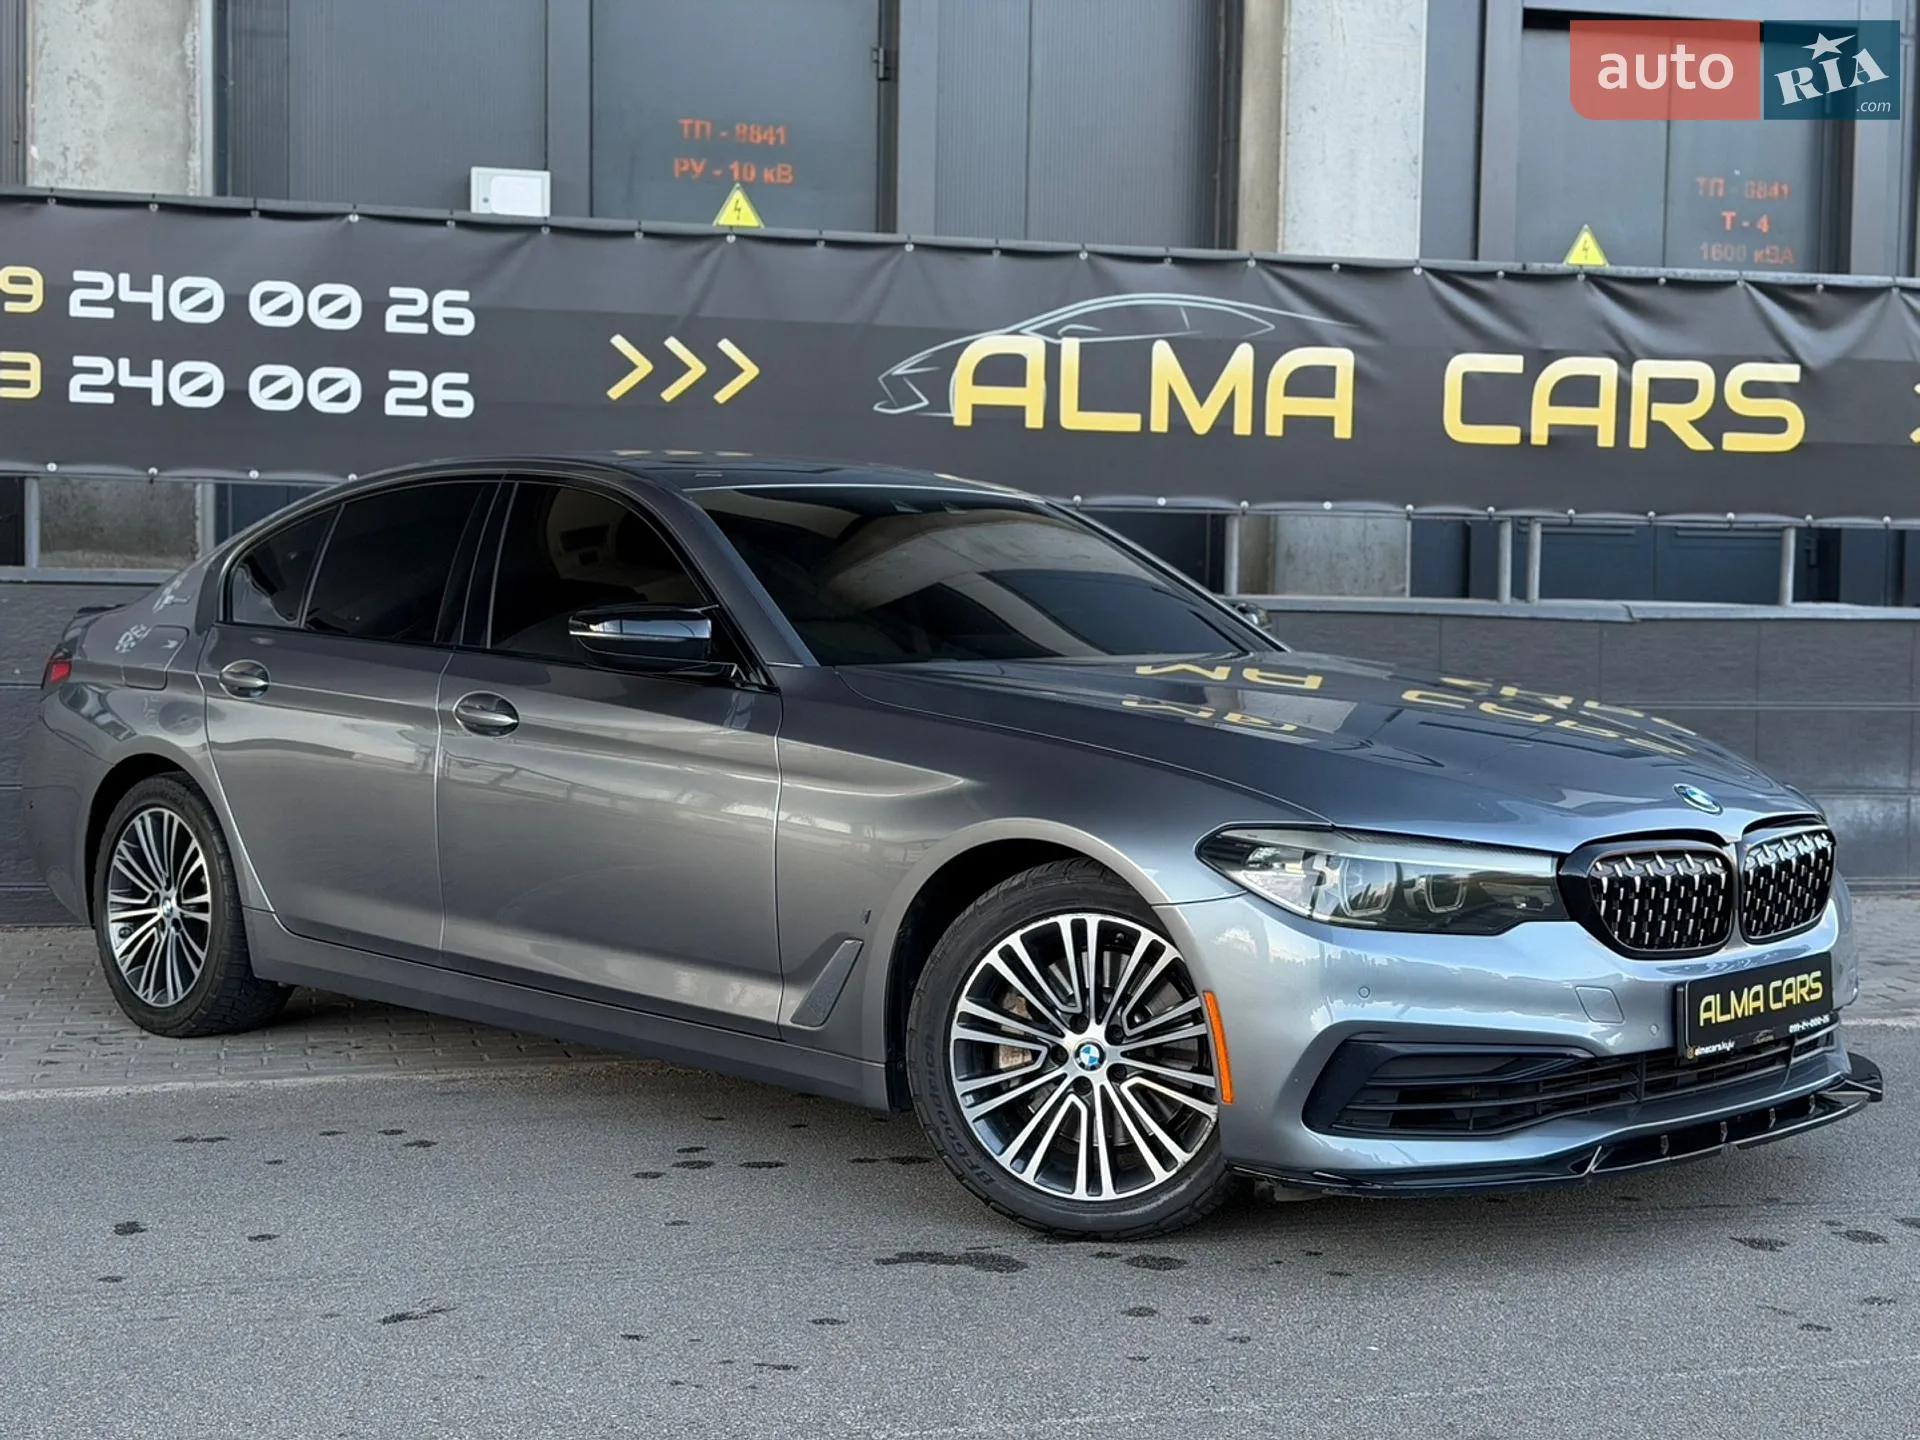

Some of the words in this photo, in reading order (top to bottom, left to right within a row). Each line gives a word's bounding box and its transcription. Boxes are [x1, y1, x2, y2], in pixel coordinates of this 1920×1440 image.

[678, 118, 712, 140] ТП
[673, 157, 707, 179] РУ
[728, 160, 757, 182] 10
[1756, 214, 1770, 233] 4
[0, 265, 44, 313] 9
[68, 269, 225, 324] 240
[248, 280, 363, 330] 00
[384, 286, 476, 336] 26
[68, 355, 225, 408] 240
[248, 364, 363, 414] 00
[384, 370, 475, 419] 26
[952, 336, 1355, 440] ALMA
[1444, 353, 1806, 452] CARS
[1699, 983, 1764, 1027] ALMA
[1768, 970, 1824, 1011] CARS
